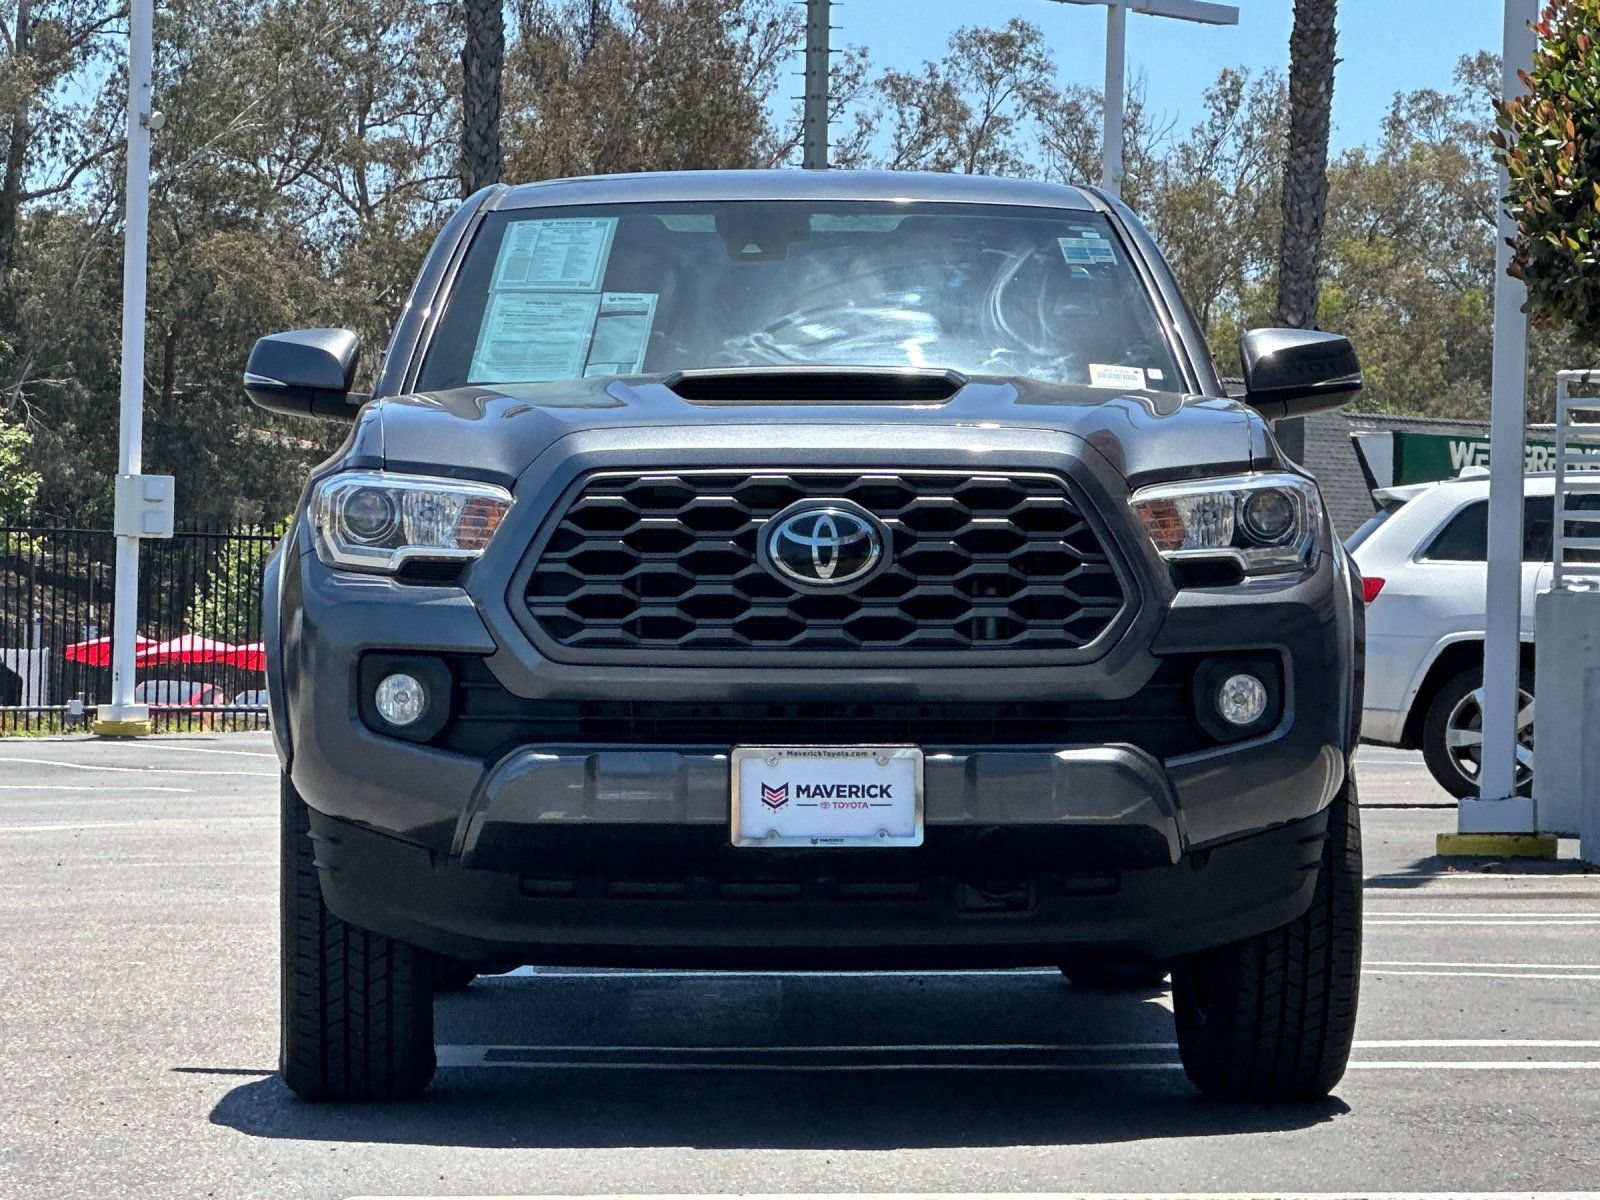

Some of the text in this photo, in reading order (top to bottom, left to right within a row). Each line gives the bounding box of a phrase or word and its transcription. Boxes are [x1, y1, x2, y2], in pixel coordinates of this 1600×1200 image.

[786, 750, 868, 758] MaverickToyota.com
[796, 784, 892, 799] MAVERICK
[832, 801, 869, 809] TOYOTA
